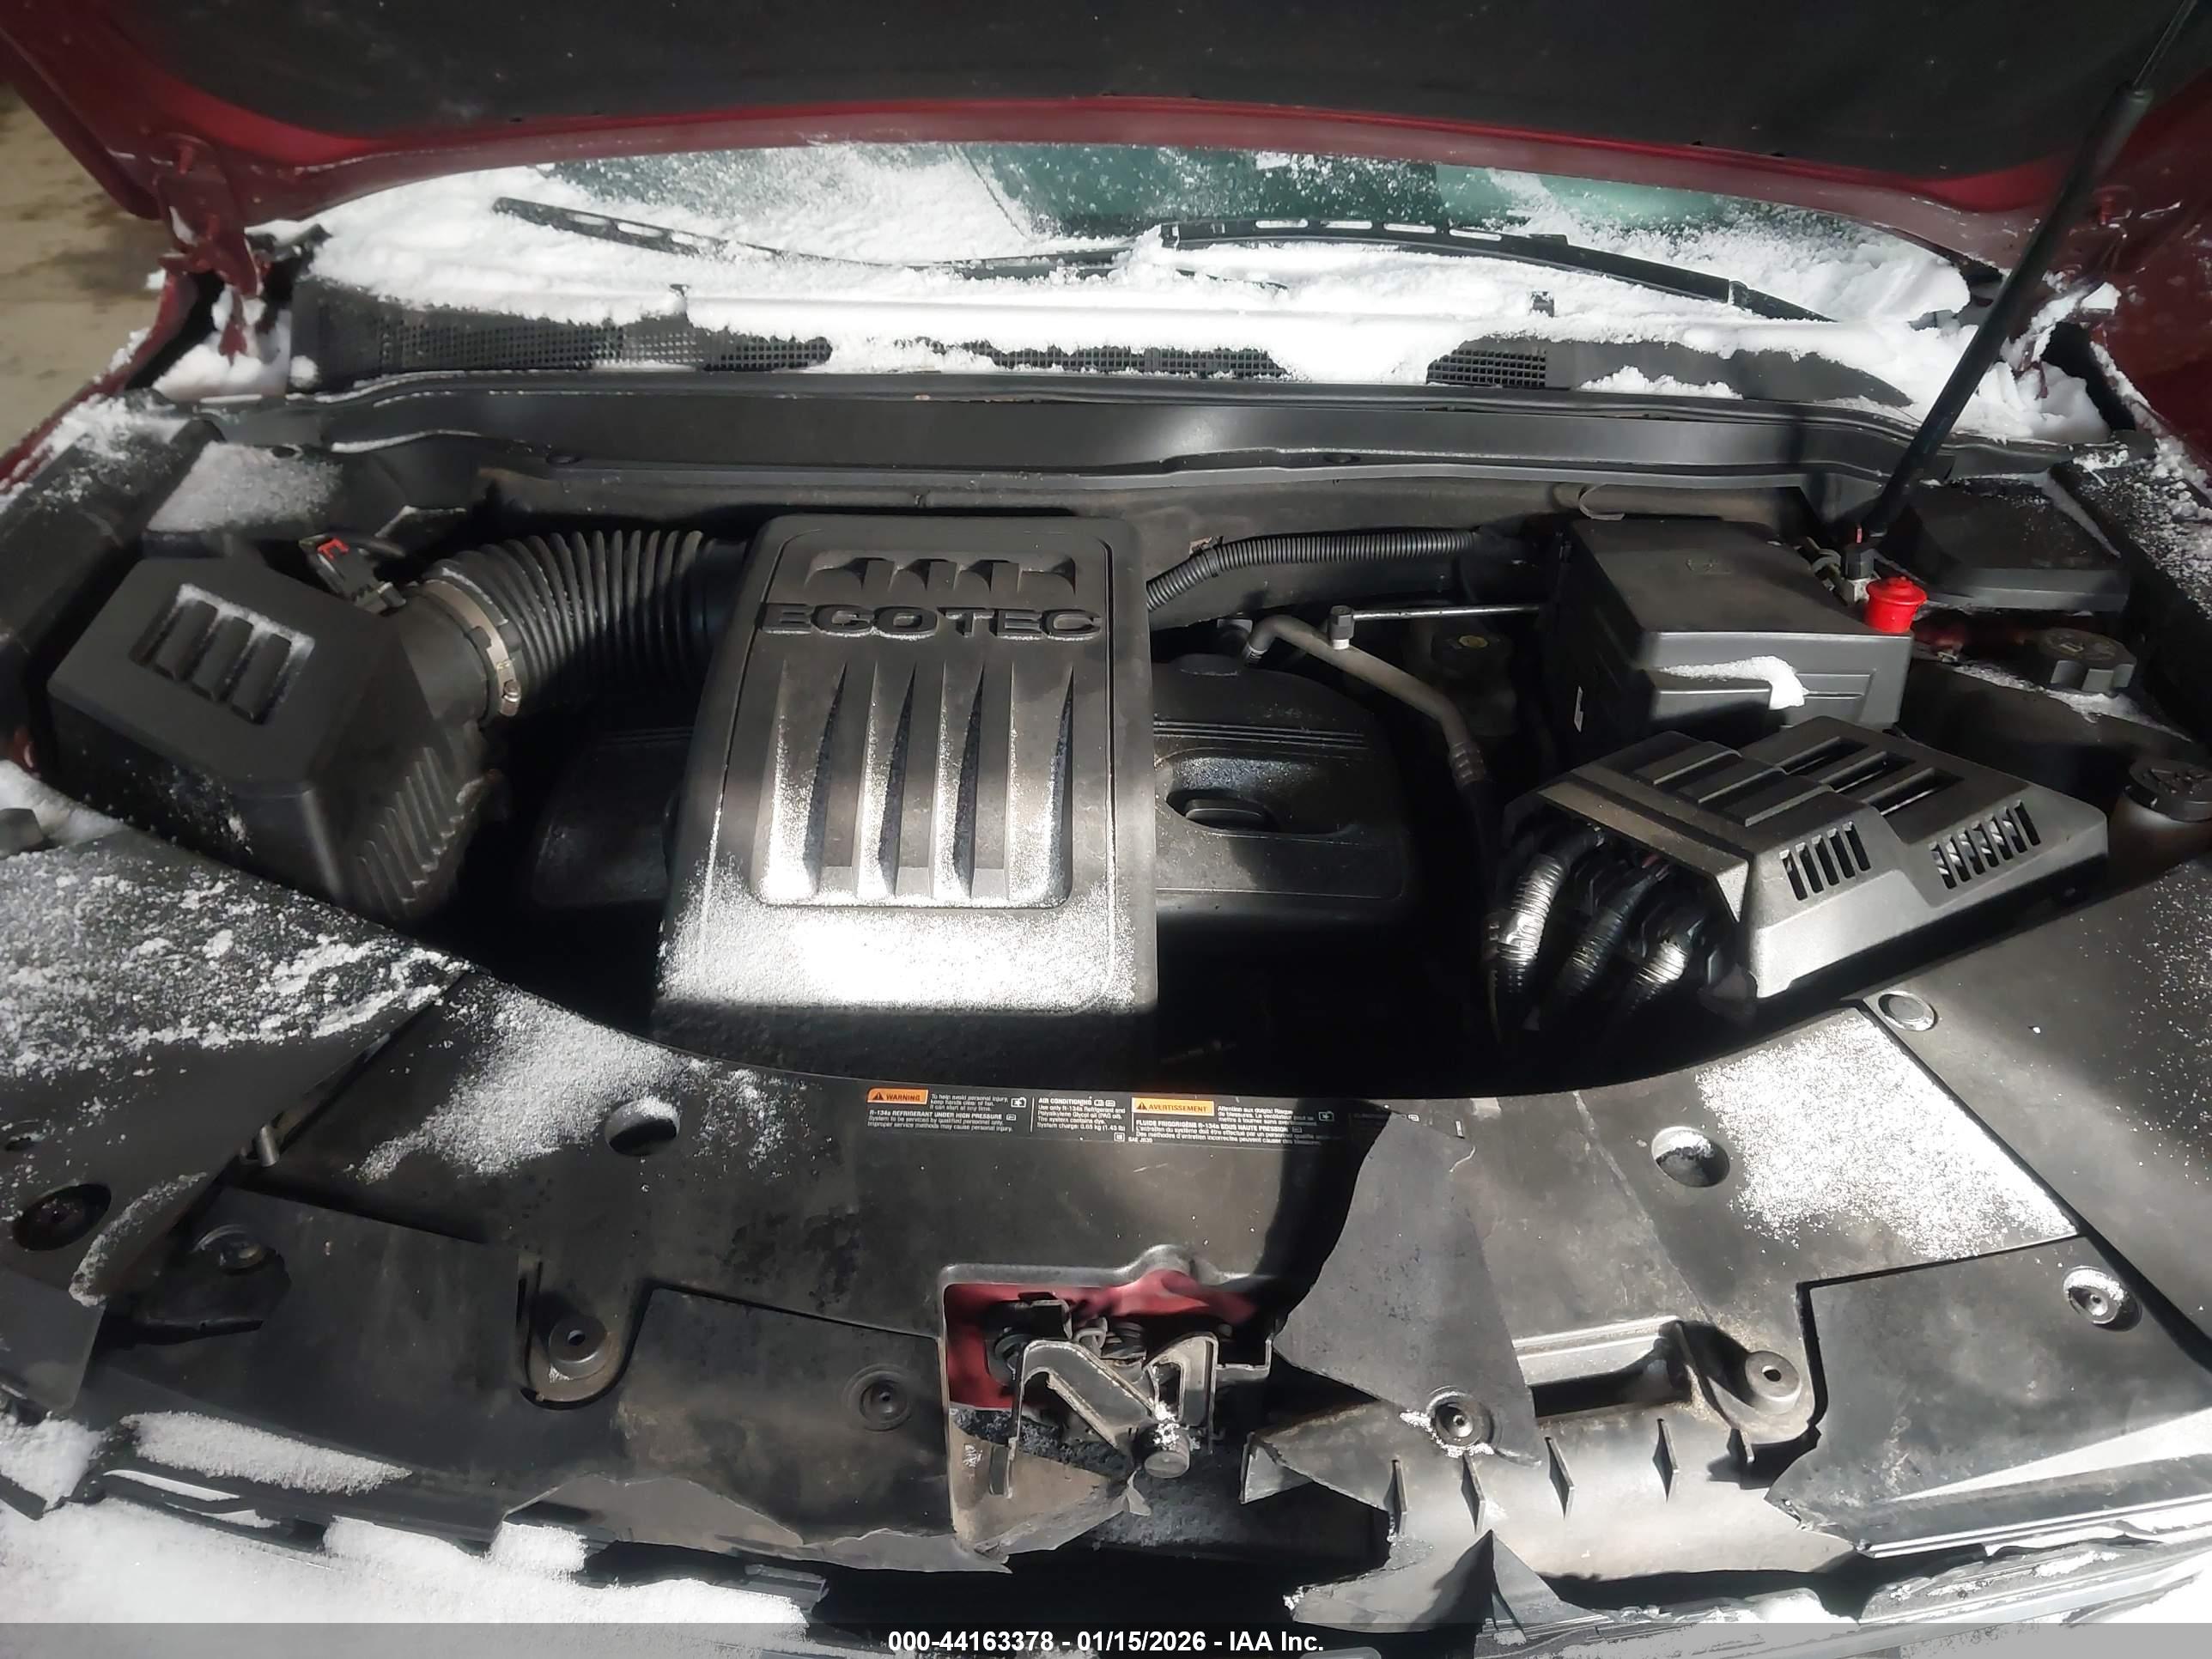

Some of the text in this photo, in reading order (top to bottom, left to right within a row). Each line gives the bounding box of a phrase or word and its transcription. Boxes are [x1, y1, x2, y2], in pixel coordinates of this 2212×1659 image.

[757, 603, 1102, 641] ECOTEC
[886, 1093, 921, 1102] WARNING
[1148, 1103, 1206, 1112] AVERTISSEMENT
